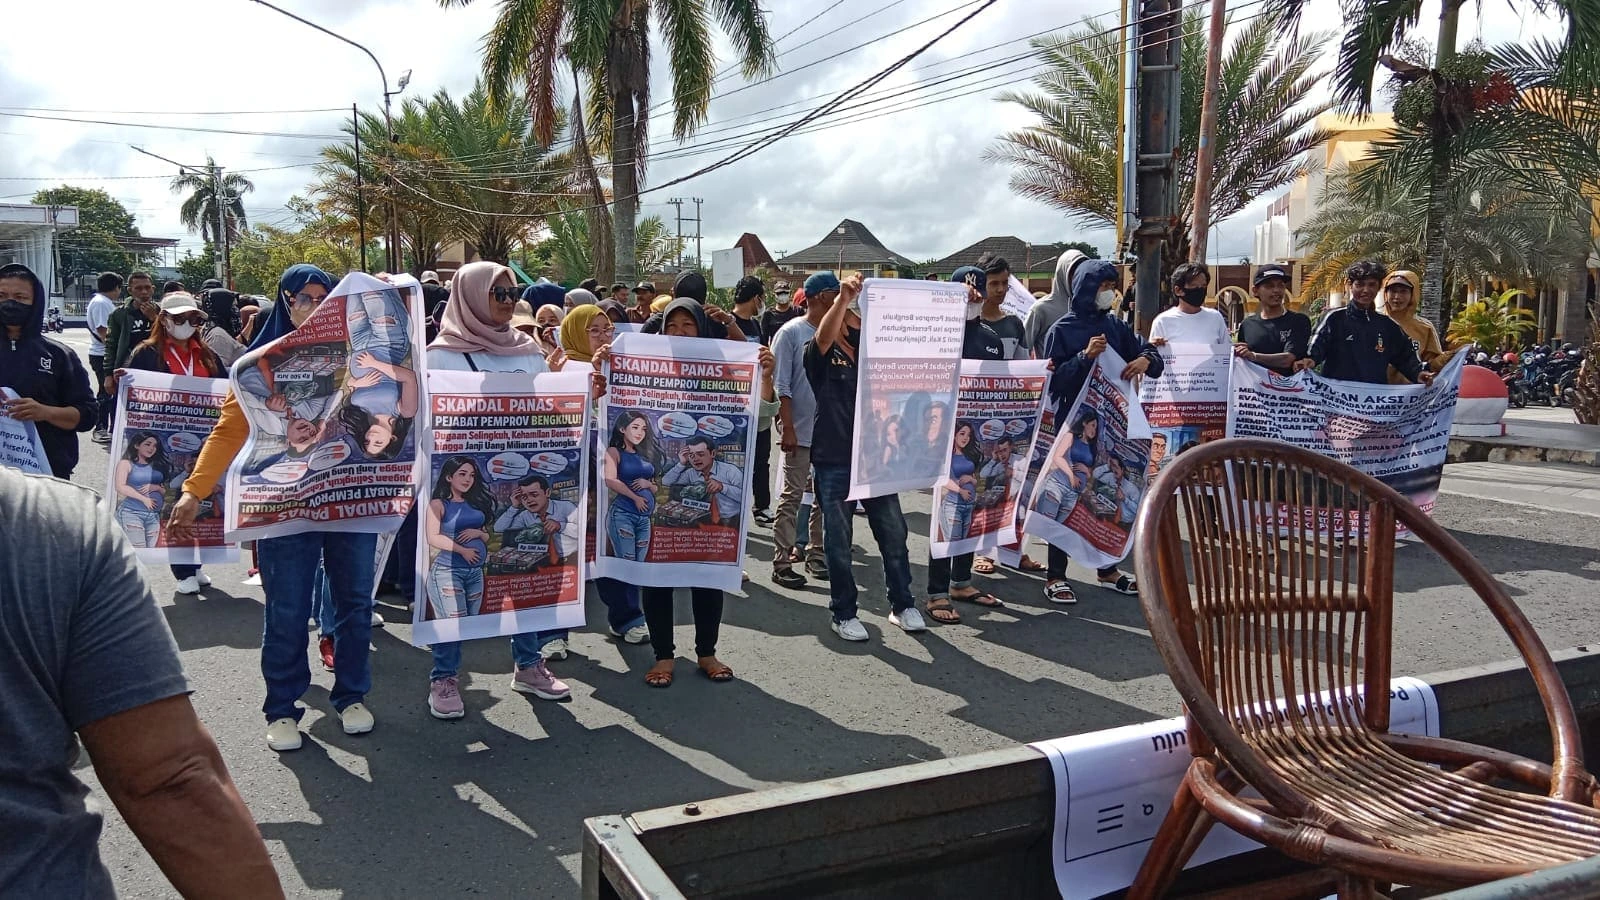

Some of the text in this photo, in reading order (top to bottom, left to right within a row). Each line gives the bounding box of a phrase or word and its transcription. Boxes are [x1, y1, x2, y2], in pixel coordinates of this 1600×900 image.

[315, 322, 342, 332] dengan
[317, 330, 343, 338] Oknum
[614, 357, 677, 375] SKANDAL
[681, 363, 723, 377] PANAS
[613, 373, 750, 392] PEJABAT PEMPROV BENGKULU!
[959, 377, 991, 389] ANDAL
[993, 378, 1025, 389] PANAS
[132, 388, 225, 407] SKANDAL PANAS
[611, 386, 640, 398] Dugaan
[959, 391, 975, 399] ABAT
[976, 391, 1008, 400] PEMPROV
[437, 397, 504, 412] SKANDAL
[509, 398, 554, 411] PANAS
[611, 395, 745, 413] hingga Janji Uang Miliaran Terbongkar
[1363, 395, 1405, 404] AKSI
[129, 401, 163, 412] PEJABAT
[165, 406, 204, 416] PEMPROV
[435, 413, 582, 427] PEJABAT PEMPROV BENGKULU!
[1235, 424, 1268, 432] KASUS
[434, 430, 467, 442] Dugaan
[512, 429, 550, 440] Kehamilan
[434, 438, 578, 452] hingga Janji Uang Miliaran Terbongkar
[332, 466, 354, 477] Uang
[356, 465, 378, 476] Janji
[379, 464, 412, 474] hingga
[376, 474, 412, 484] Dugaan
[246, 485, 298, 494] Terbongkar
[362, 487, 412, 498] PEJABAT
[309, 488, 361, 507] PEMPROV
[278, 499, 410, 522] SKANDAL PANAS
